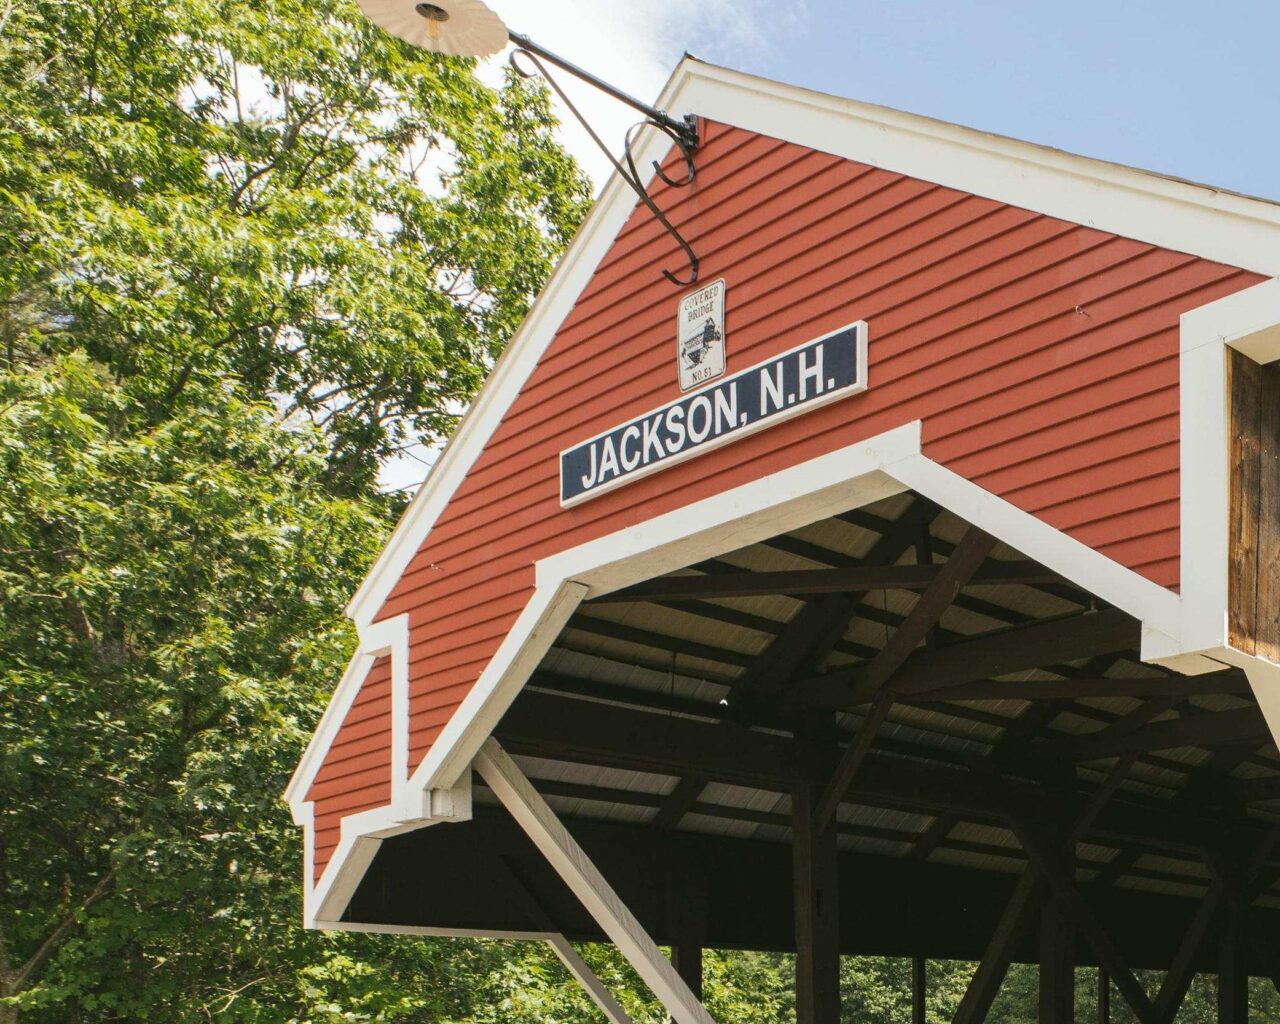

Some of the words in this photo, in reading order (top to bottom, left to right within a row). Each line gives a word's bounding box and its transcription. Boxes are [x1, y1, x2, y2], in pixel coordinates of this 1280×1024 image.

[684, 286, 719, 311] COVERED
[688, 301, 714, 322] BRIDGE
[581, 382, 747, 490] JACKSON,
[760, 344, 835, 416] N.H.
